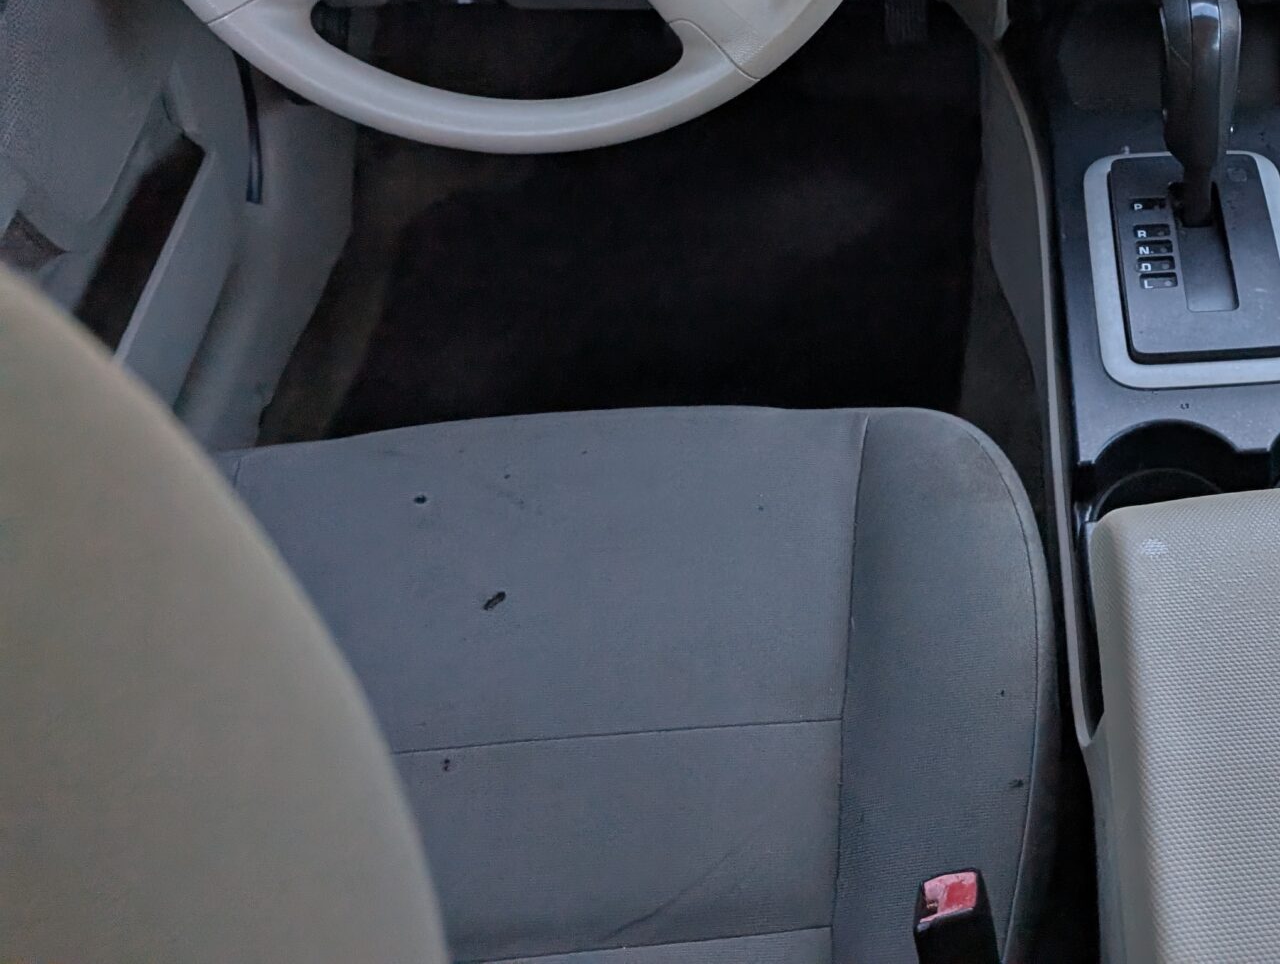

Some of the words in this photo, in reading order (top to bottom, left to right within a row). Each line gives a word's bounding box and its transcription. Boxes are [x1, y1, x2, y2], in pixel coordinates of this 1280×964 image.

[1133, 203, 1143, 211] P
[1137, 229, 1147, 238] R
[1138, 246, 1150, 255] N
[1140, 262, 1152, 272] D
[1144, 279, 1154, 289] L
